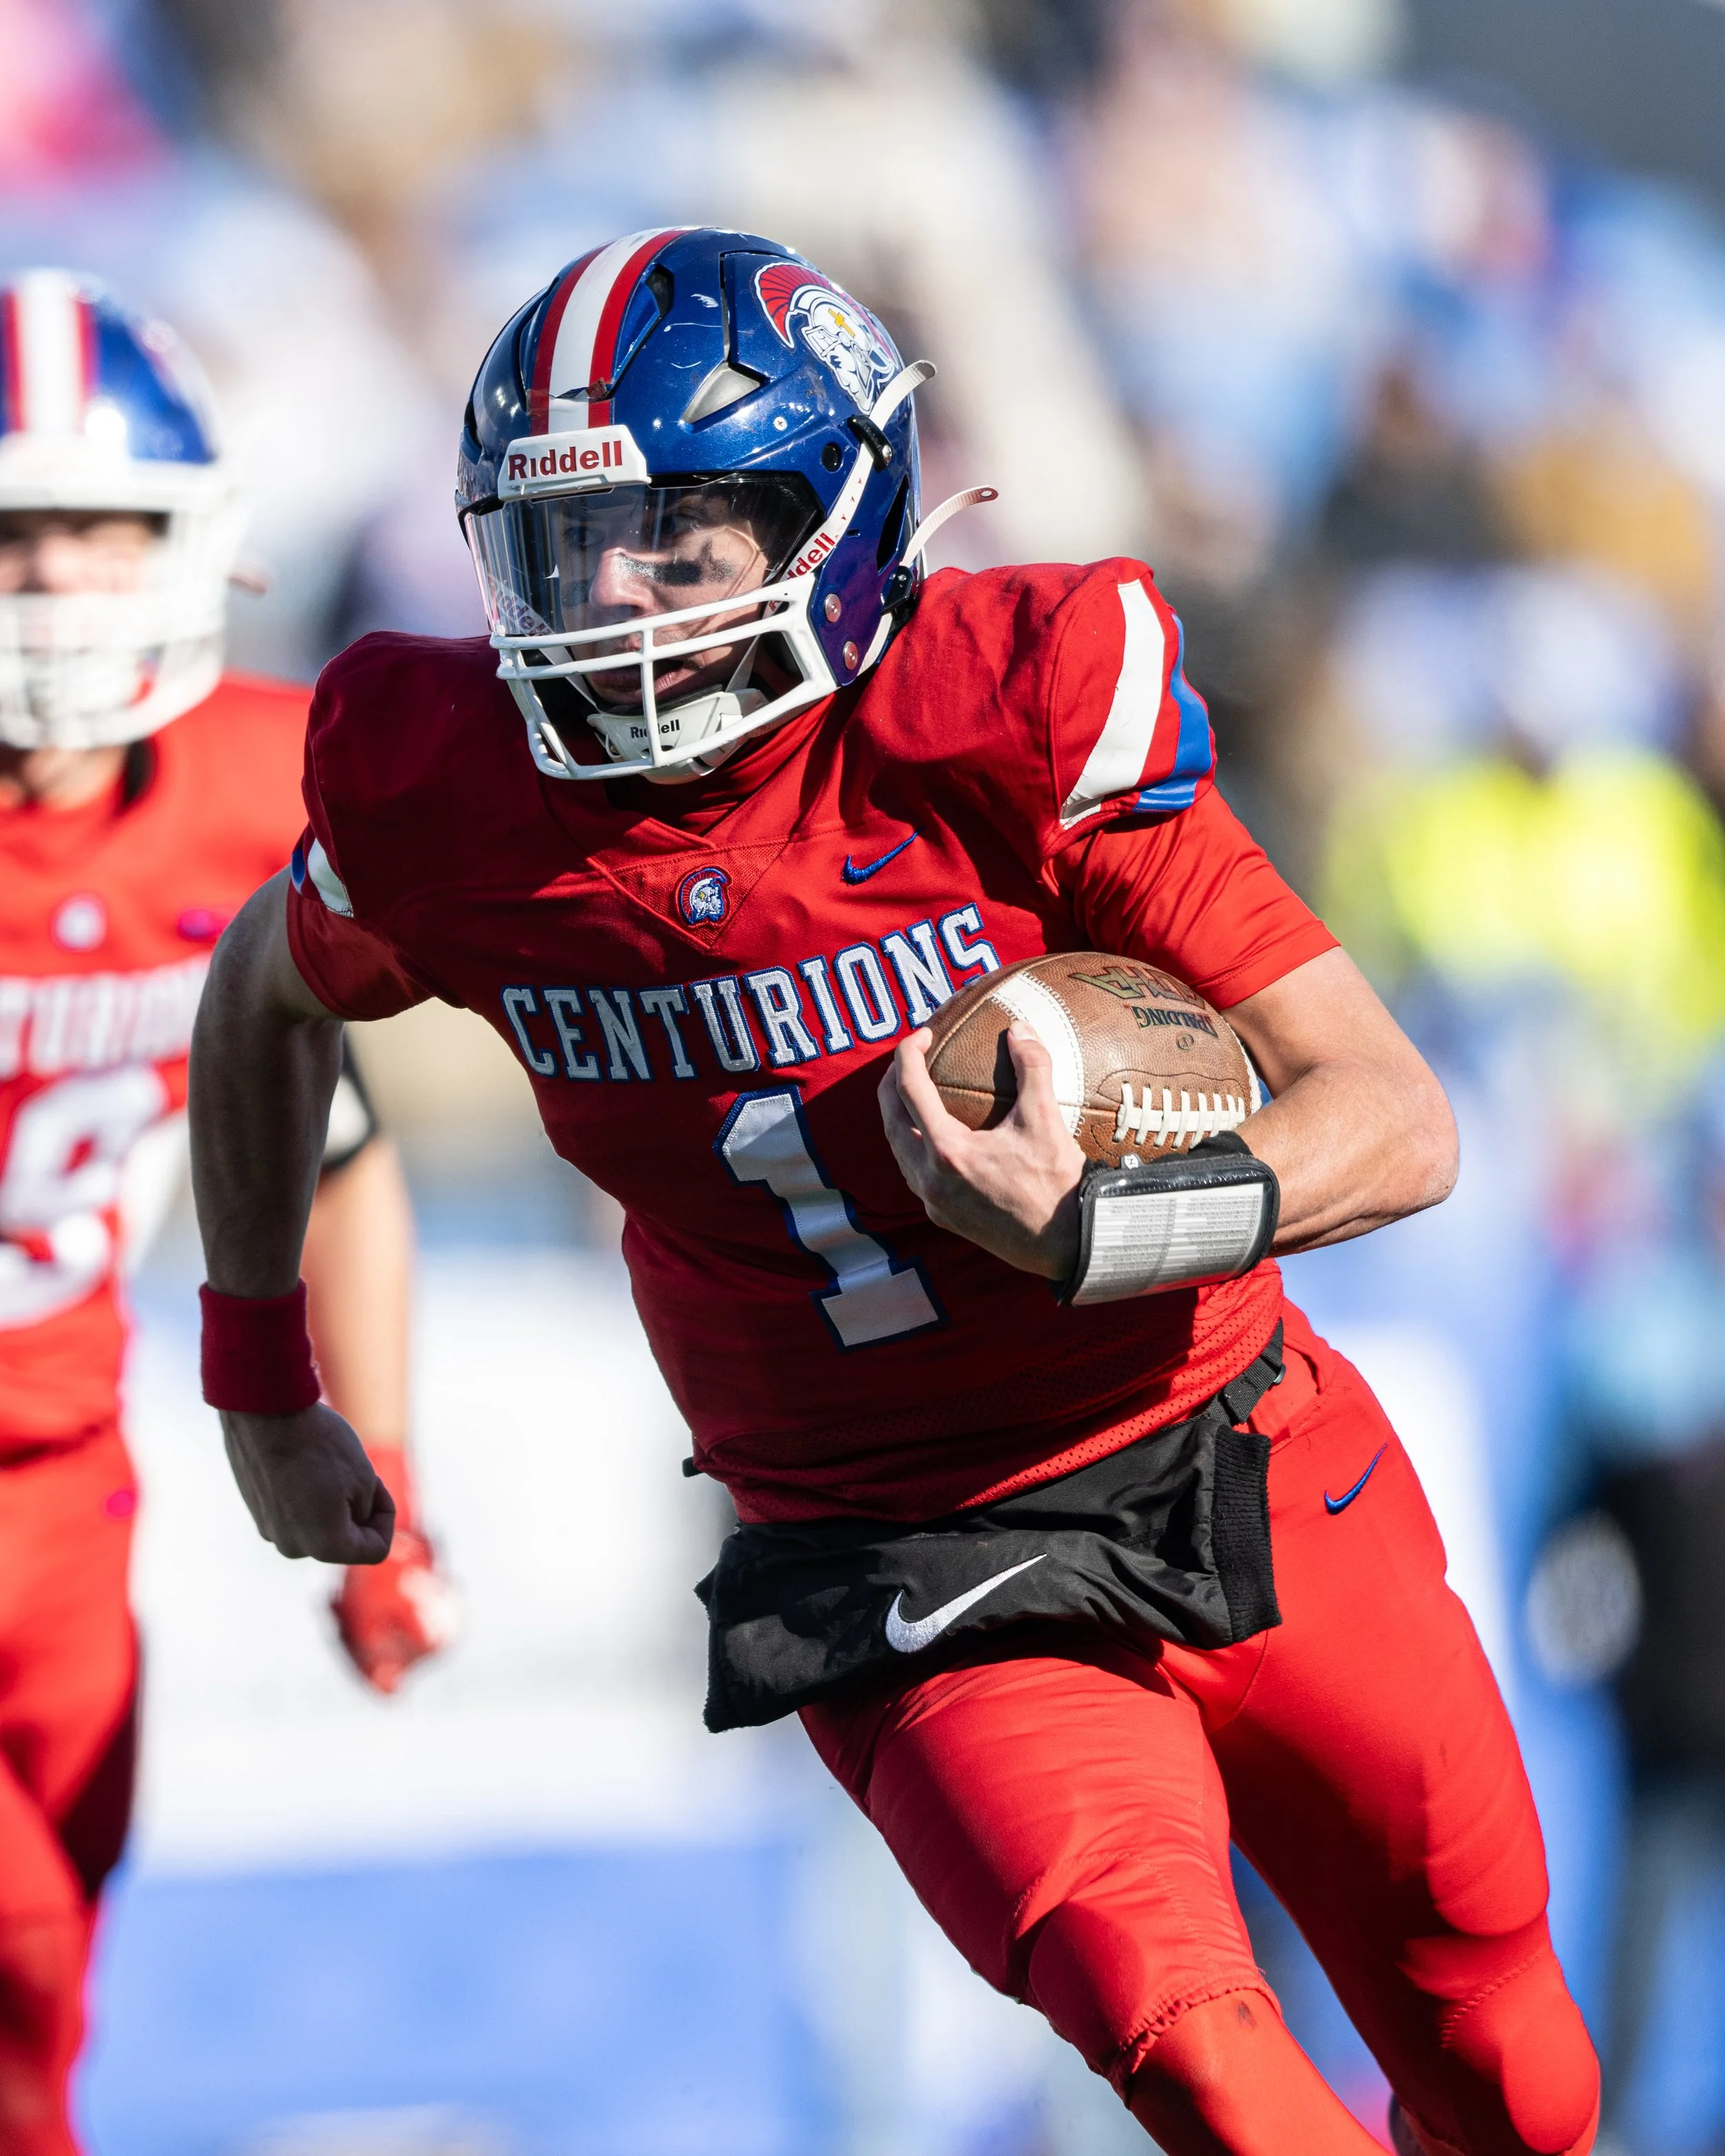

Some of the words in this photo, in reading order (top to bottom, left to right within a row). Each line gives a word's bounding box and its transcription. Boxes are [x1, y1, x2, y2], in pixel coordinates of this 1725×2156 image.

[509, 440, 622, 481] Riddell
[500, 902, 1000, 1082] CENTURIONS
[1130, 1005, 1219, 1038] SPALDING
[712, 1085, 950, 1354] 1
